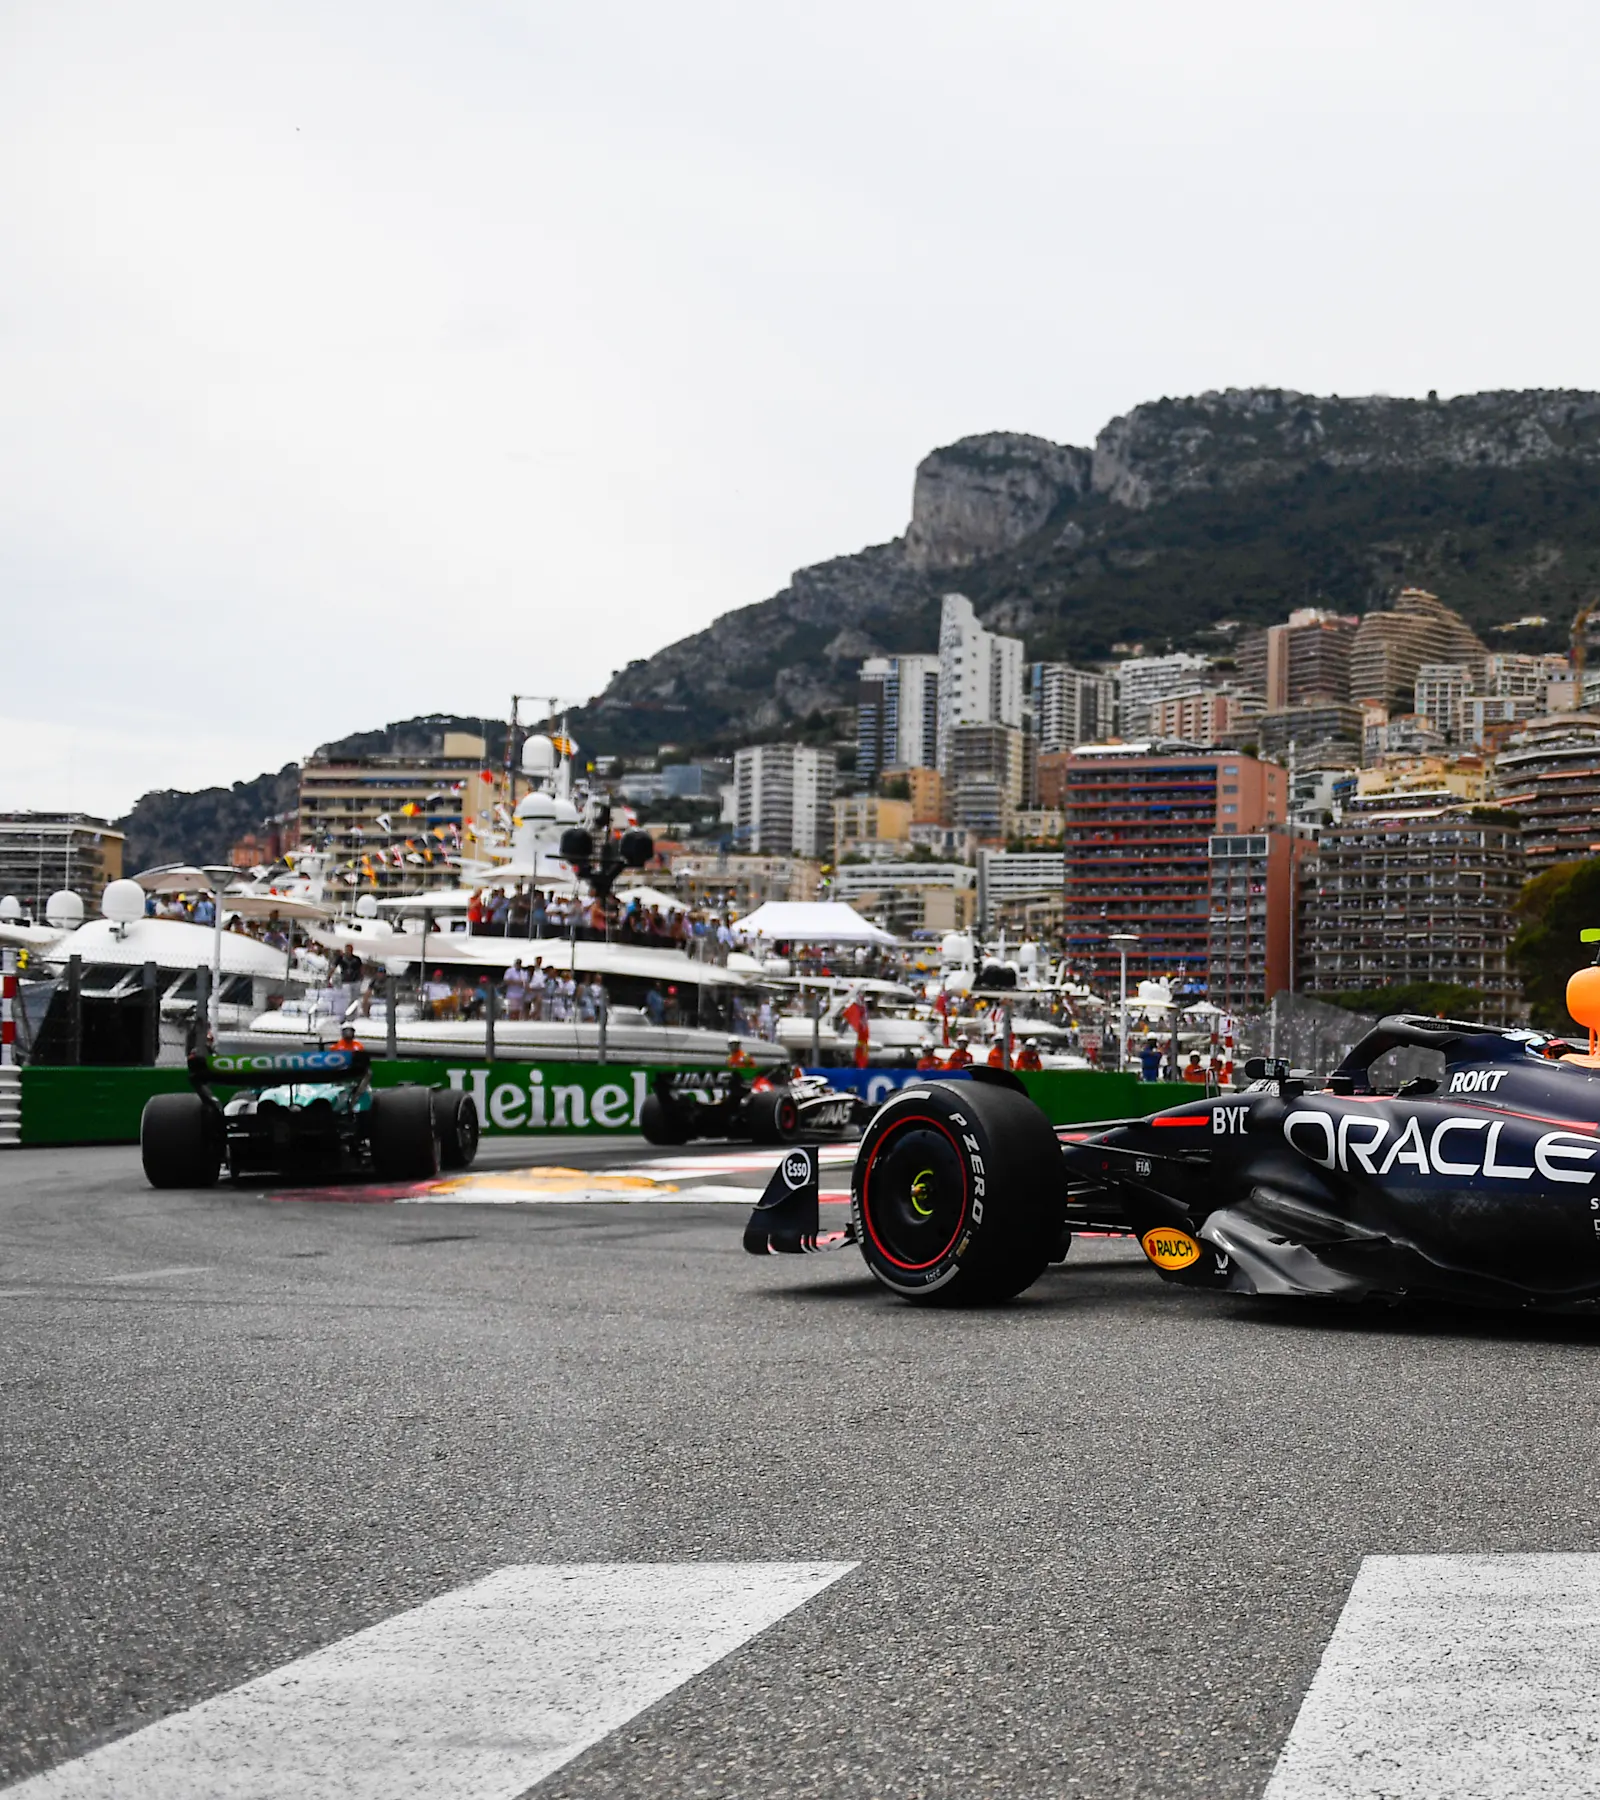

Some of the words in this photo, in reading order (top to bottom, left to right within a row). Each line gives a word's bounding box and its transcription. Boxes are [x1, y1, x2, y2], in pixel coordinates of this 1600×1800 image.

[212, 1053, 347, 1071] aramco
[1449, 1070, 1508, 1093] ROKT
[787, 1159, 807, 1177] Esso
[950, 1113, 967, 1127] P
[963, 1134, 985, 1224] ZERO
[1136, 1162, 1150, 1173] FIA
[1156, 1240, 1193, 1257] RAUCH
